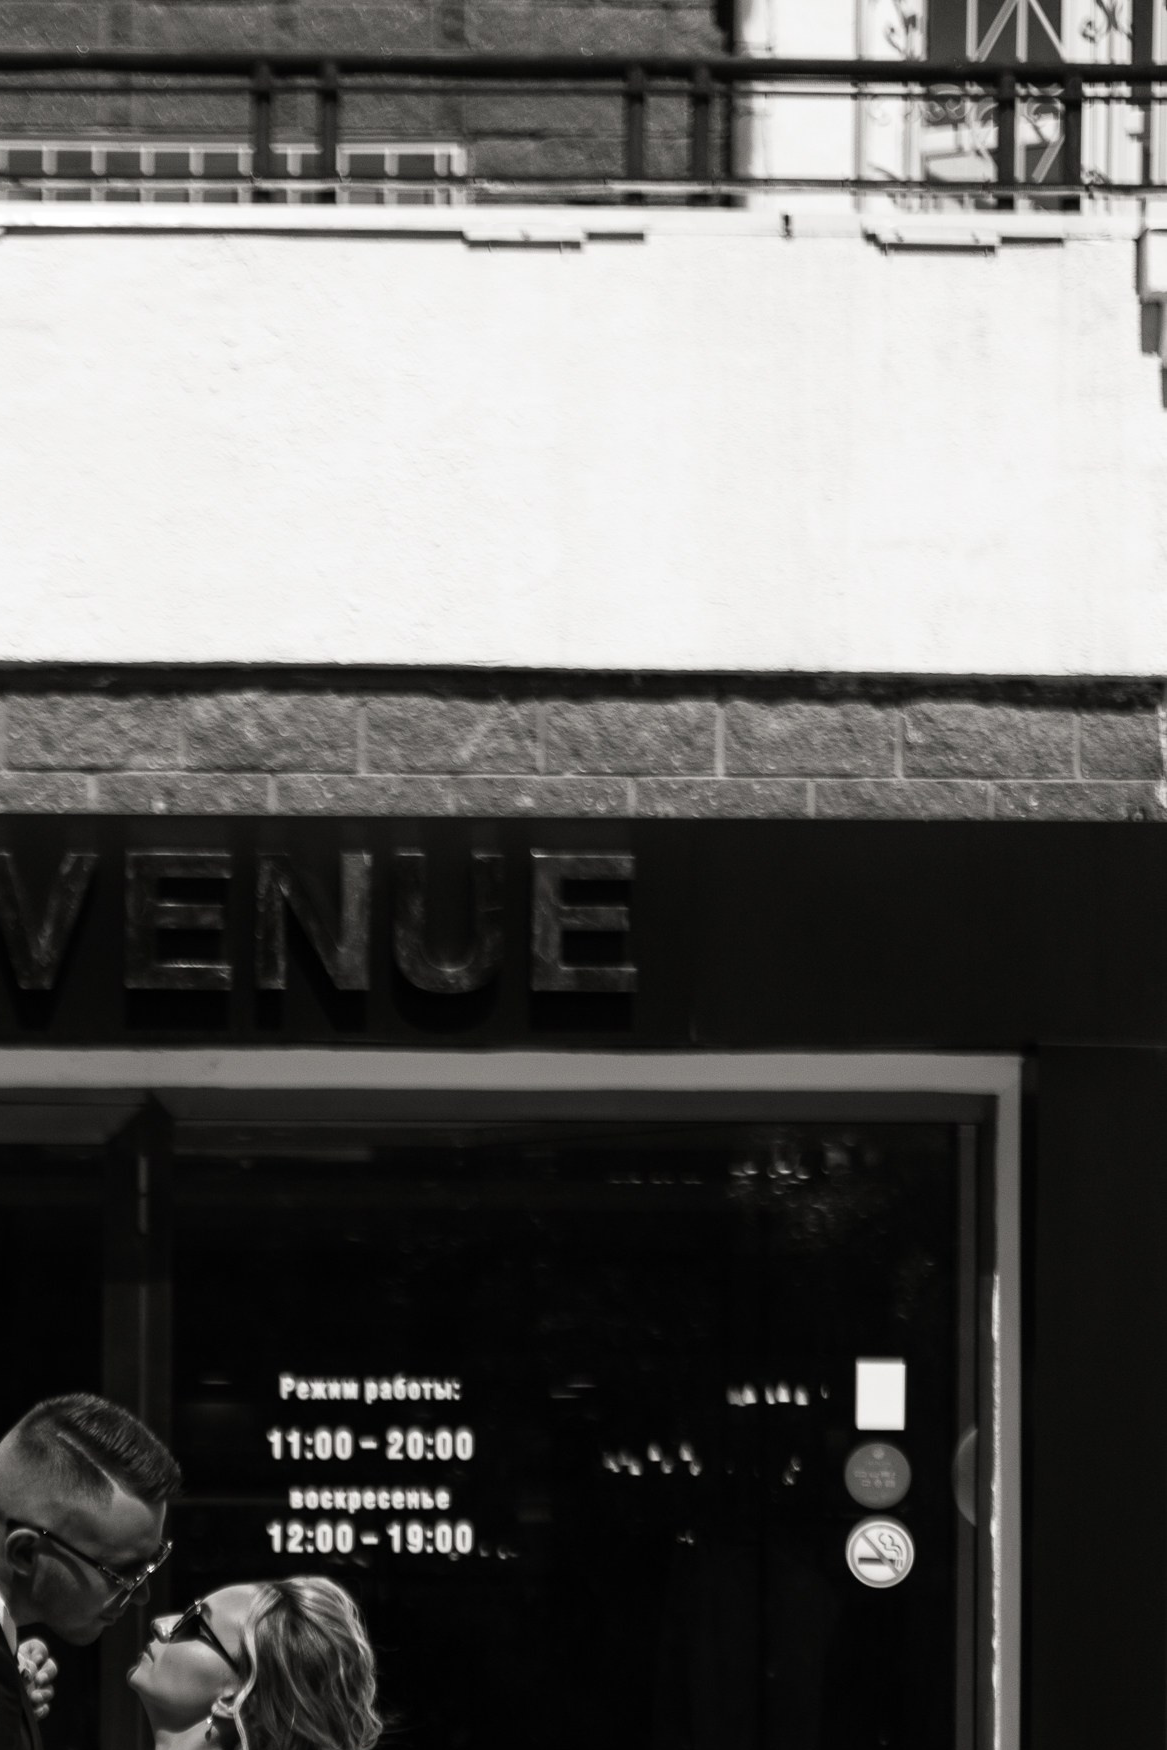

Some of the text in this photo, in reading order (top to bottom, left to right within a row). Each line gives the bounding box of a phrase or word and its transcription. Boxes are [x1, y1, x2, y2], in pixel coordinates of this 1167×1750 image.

[279, 1374, 461, 1404] Режим работы:
[267, 1428, 353, 1460] 11:00
[386, 1428, 473, 1460] 20:00
[289, 1488, 450, 1514] воскресенье
[267, 1521, 354, 1553] 12:00
[386, 1522, 473, 1553] 19:00
